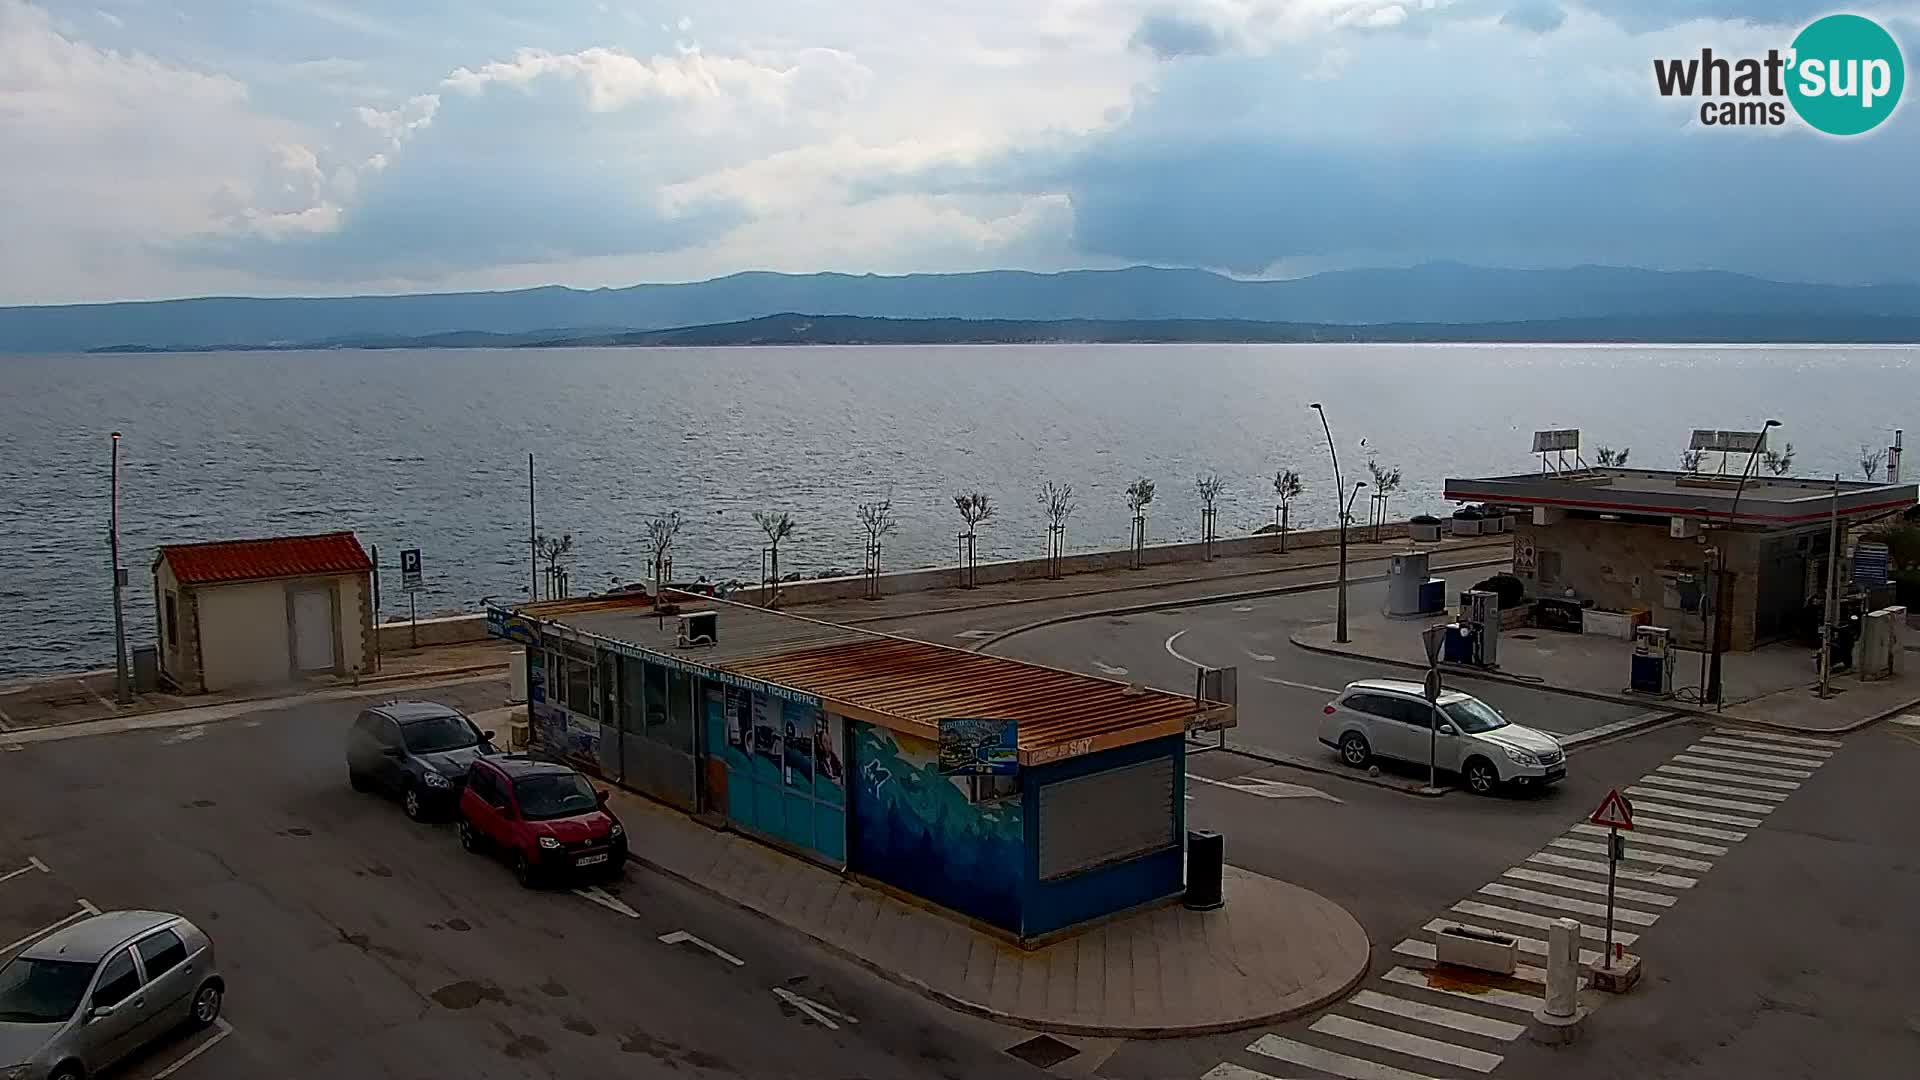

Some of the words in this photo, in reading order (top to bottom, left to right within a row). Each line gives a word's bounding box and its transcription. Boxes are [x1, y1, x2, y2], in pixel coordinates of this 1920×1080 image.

[405, 553, 417, 570] P
[736, 677, 765, 693] STATION
[767, 685, 791, 700] TICKET
[792, 692, 817, 706] OFFICE
